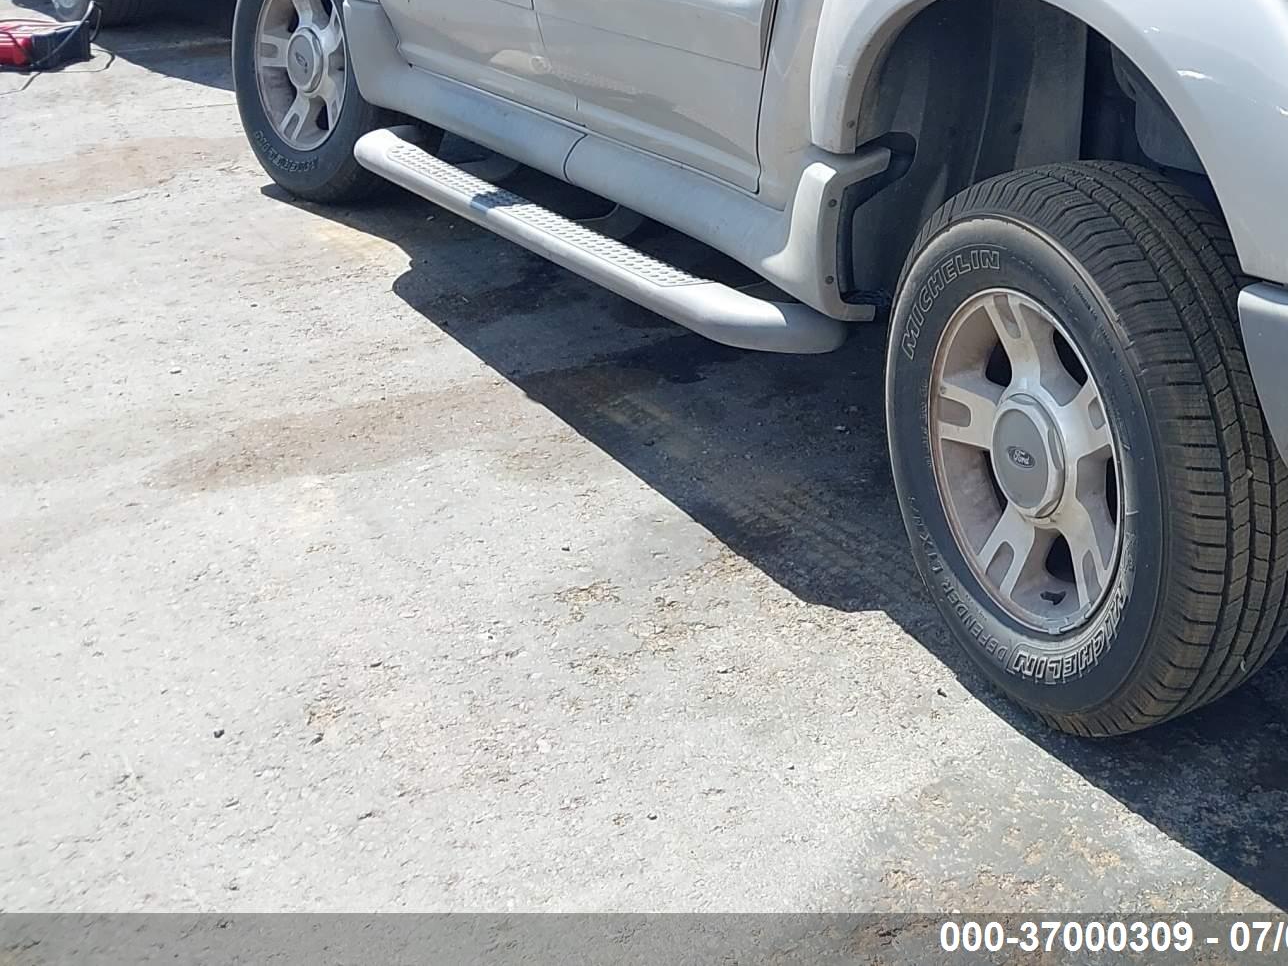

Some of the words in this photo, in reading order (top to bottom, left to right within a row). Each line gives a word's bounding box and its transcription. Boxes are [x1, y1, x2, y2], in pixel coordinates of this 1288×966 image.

[902, 249, 1001, 360] MICHELIN
[1013, 449, 1030, 465] Ford
[941, 576, 1008, 661] DEFENDER
[1013, 586, 1128, 679] MICHELIN
